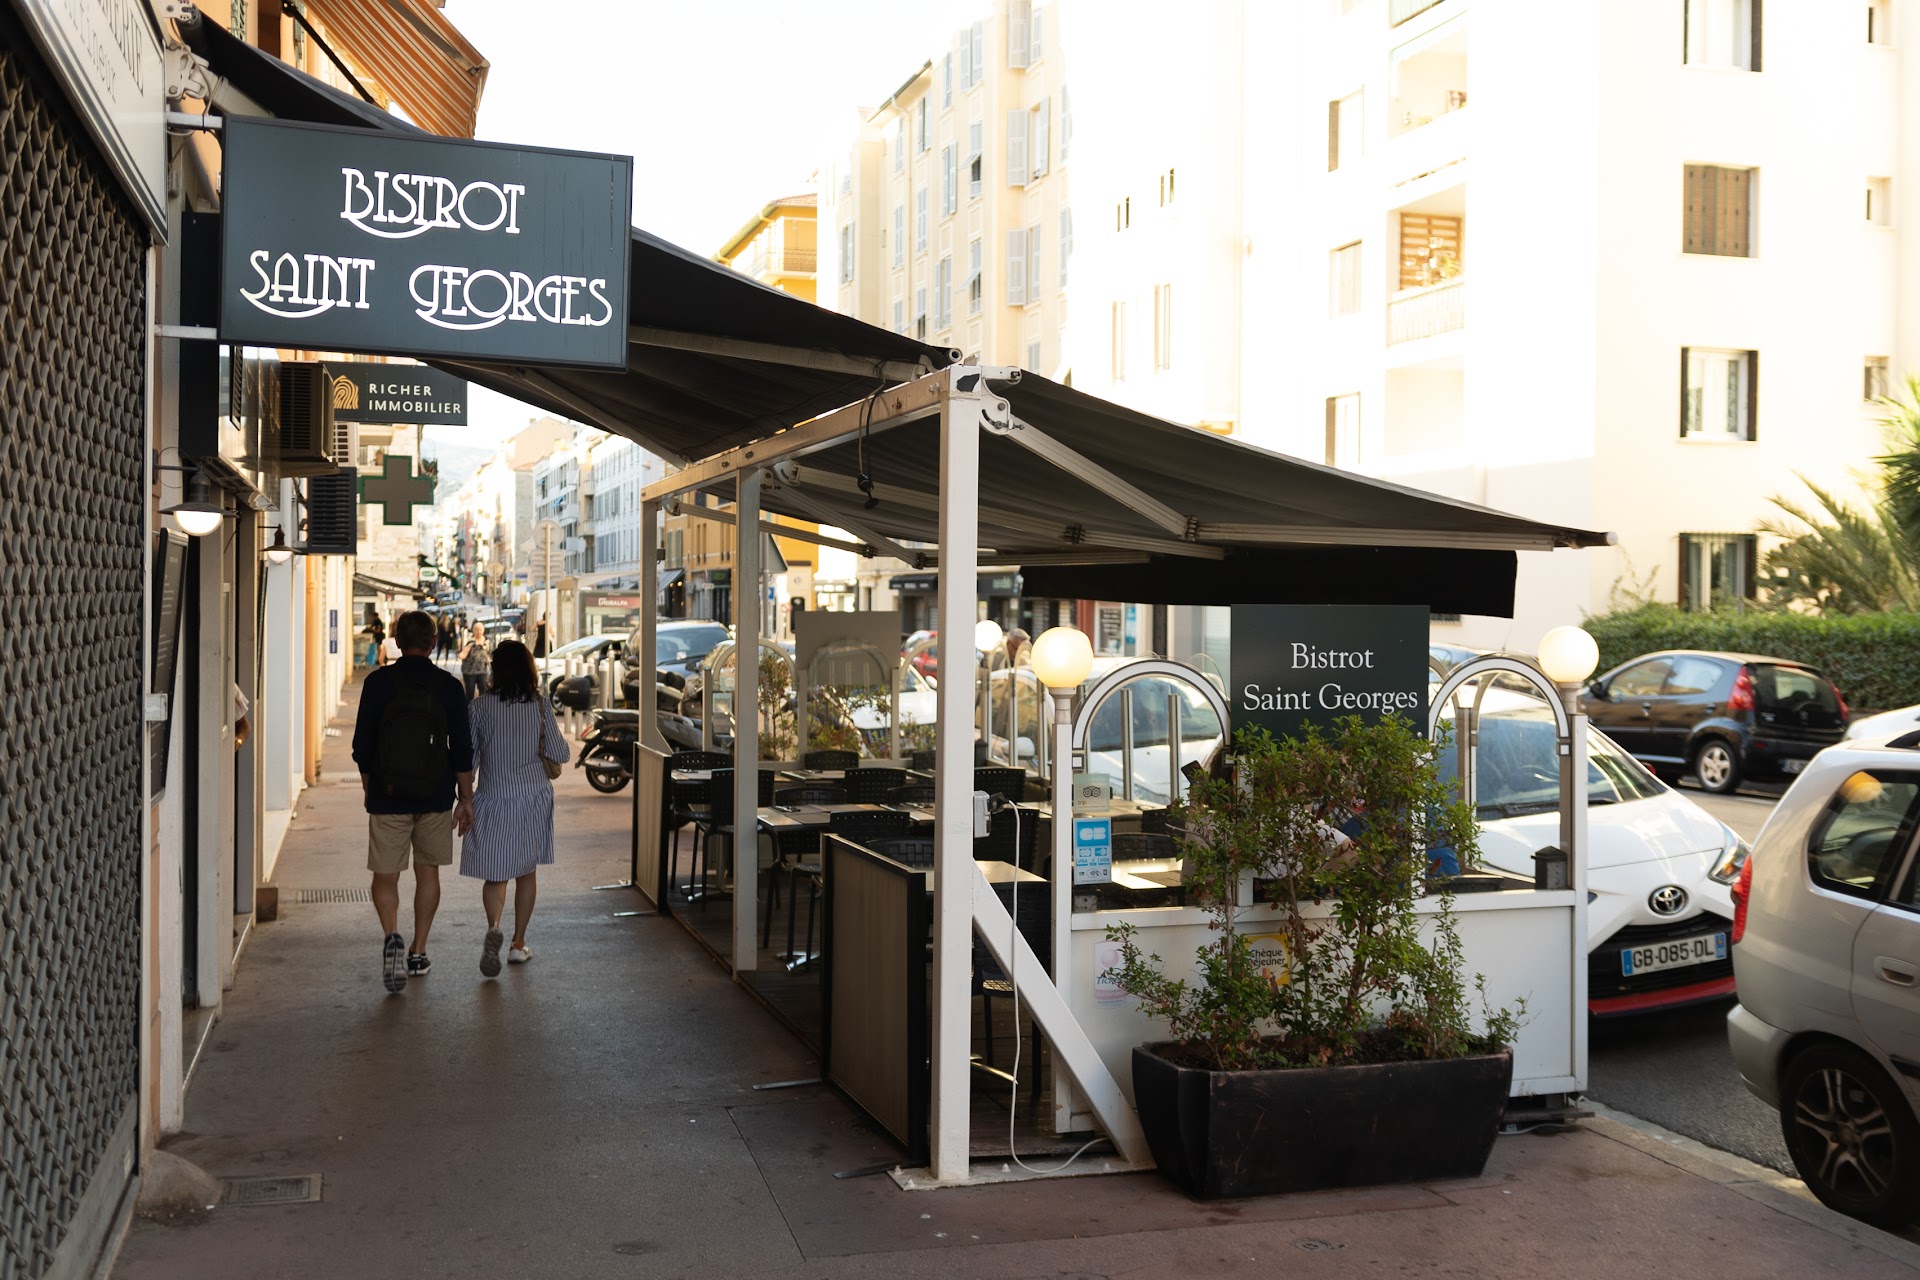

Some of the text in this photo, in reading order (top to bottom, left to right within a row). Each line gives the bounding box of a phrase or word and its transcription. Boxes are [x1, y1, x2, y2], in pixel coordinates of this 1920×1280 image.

[341, 168, 525, 238] BISTROT
[240, 250, 612, 330] SAINT GEORGES
[370, 384, 431, 396] RICHER
[369, 400, 460, 413] IMMOBILIER
[1291, 643, 1373, 668] Bistrot
[1244, 684, 1417, 715] Saint Georges
[1633, 939, 1714, 968] GB-085-DL
